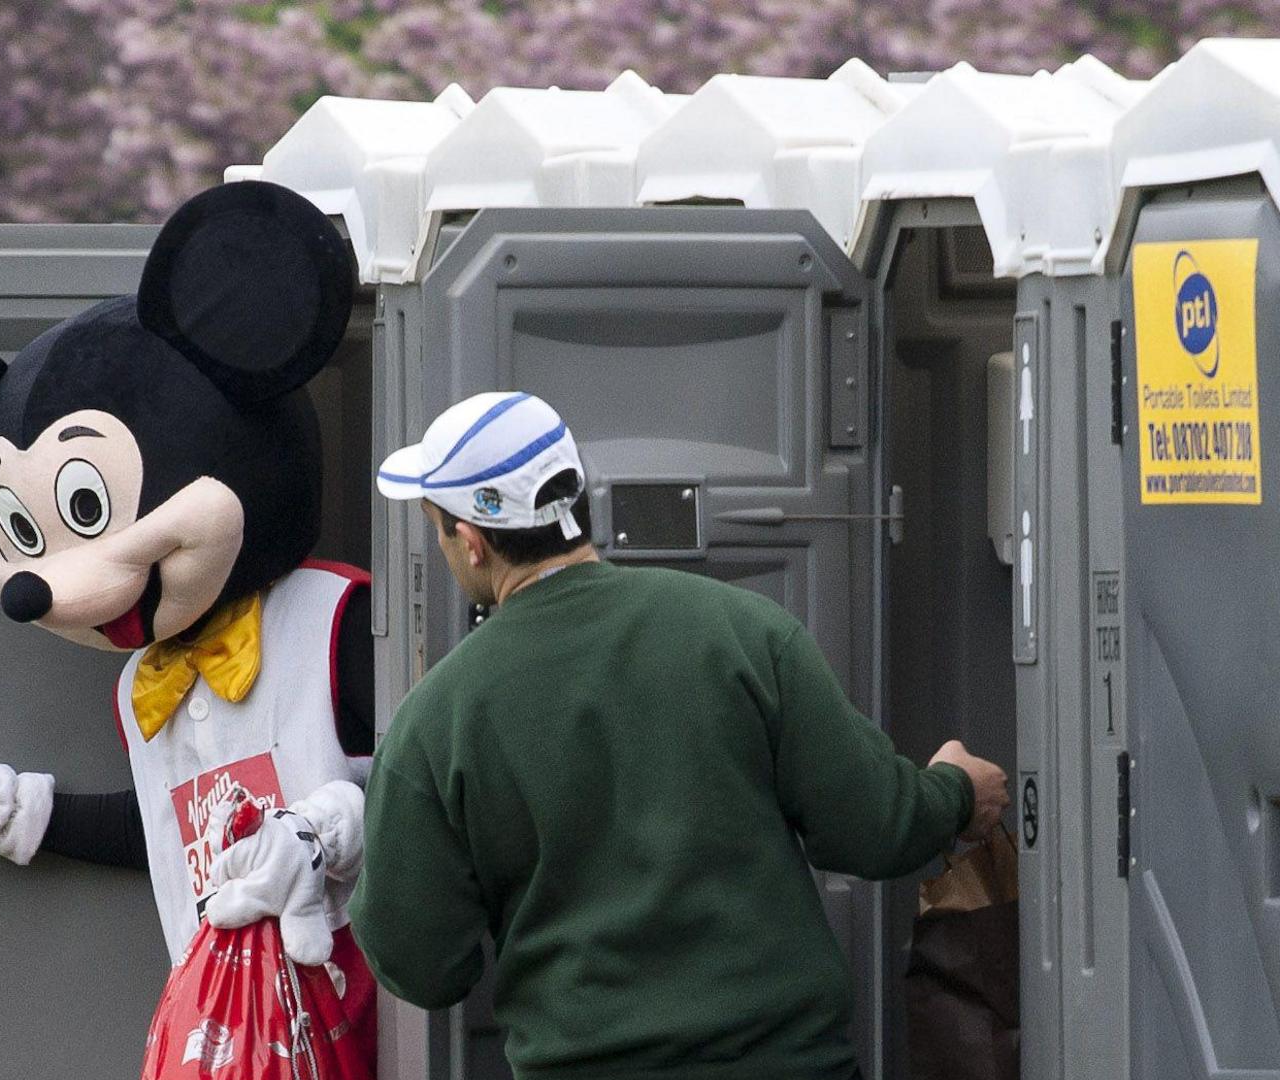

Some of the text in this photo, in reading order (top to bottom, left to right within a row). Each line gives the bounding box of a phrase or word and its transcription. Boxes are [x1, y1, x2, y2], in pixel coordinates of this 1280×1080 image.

[1181, 291, 1210, 335] ptl
[1144, 384, 1252, 409] Portable Toilets Limited
[1149, 422, 1171, 460] Tel:
[1172, 422, 1210, 460] 08702
[1213, 422, 1232, 460] 407
